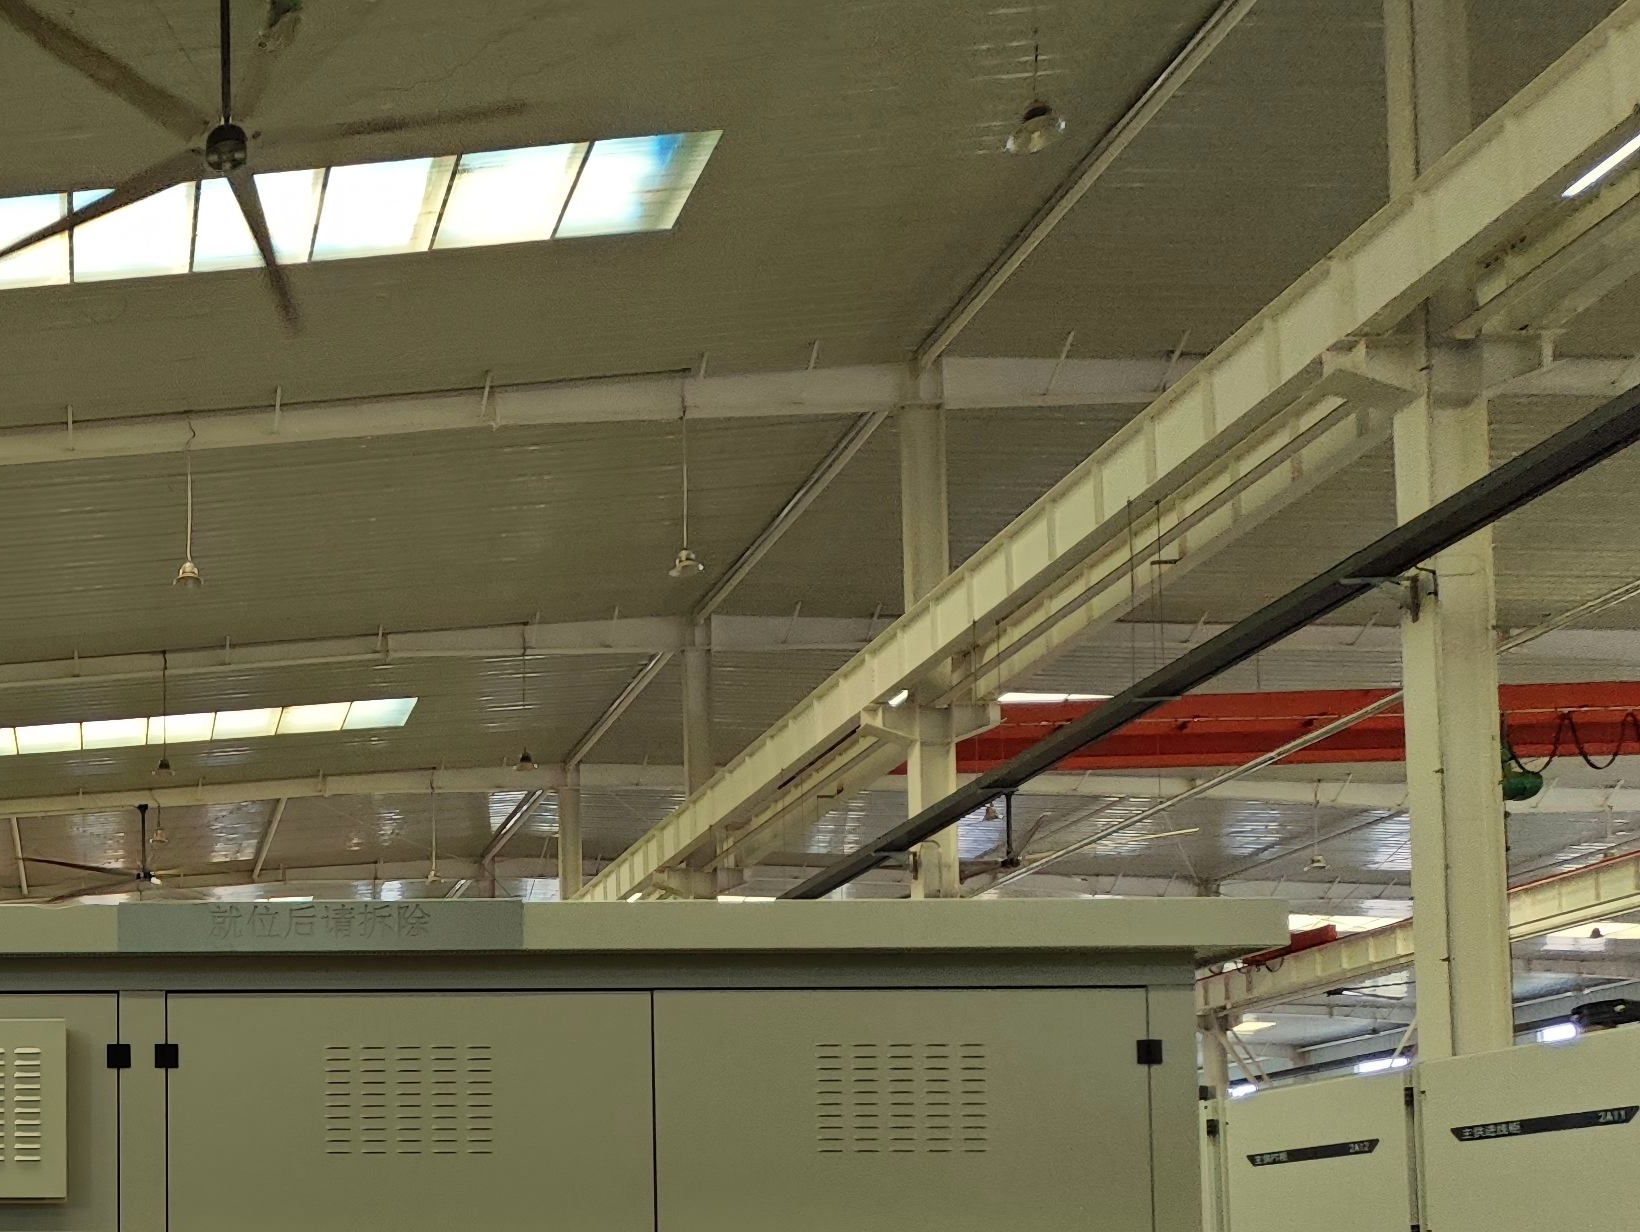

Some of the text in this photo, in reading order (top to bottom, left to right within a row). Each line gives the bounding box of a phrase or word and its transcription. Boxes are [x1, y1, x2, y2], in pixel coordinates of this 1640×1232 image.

[207, 903, 432, 940] 就位后请拆除
